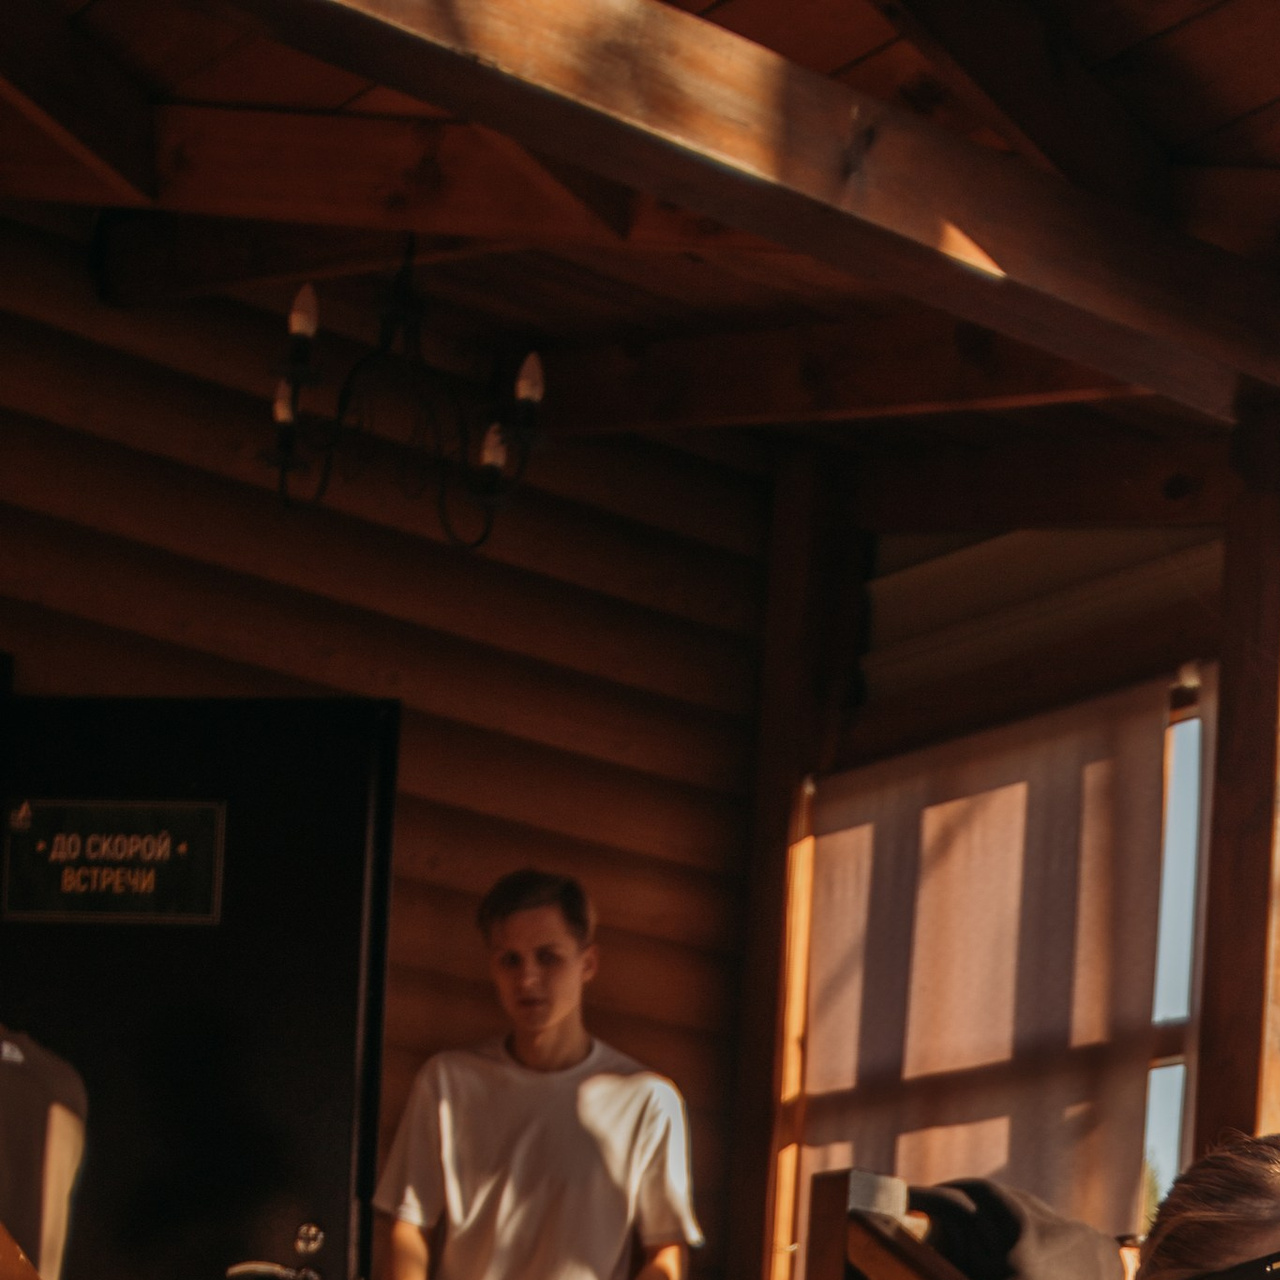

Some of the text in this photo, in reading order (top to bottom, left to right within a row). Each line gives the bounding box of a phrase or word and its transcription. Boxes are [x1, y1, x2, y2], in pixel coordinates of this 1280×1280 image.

[49, 830, 172, 863] ДО СКОРОЙ
[60, 866, 156, 893] ВСТРЕЧИ
